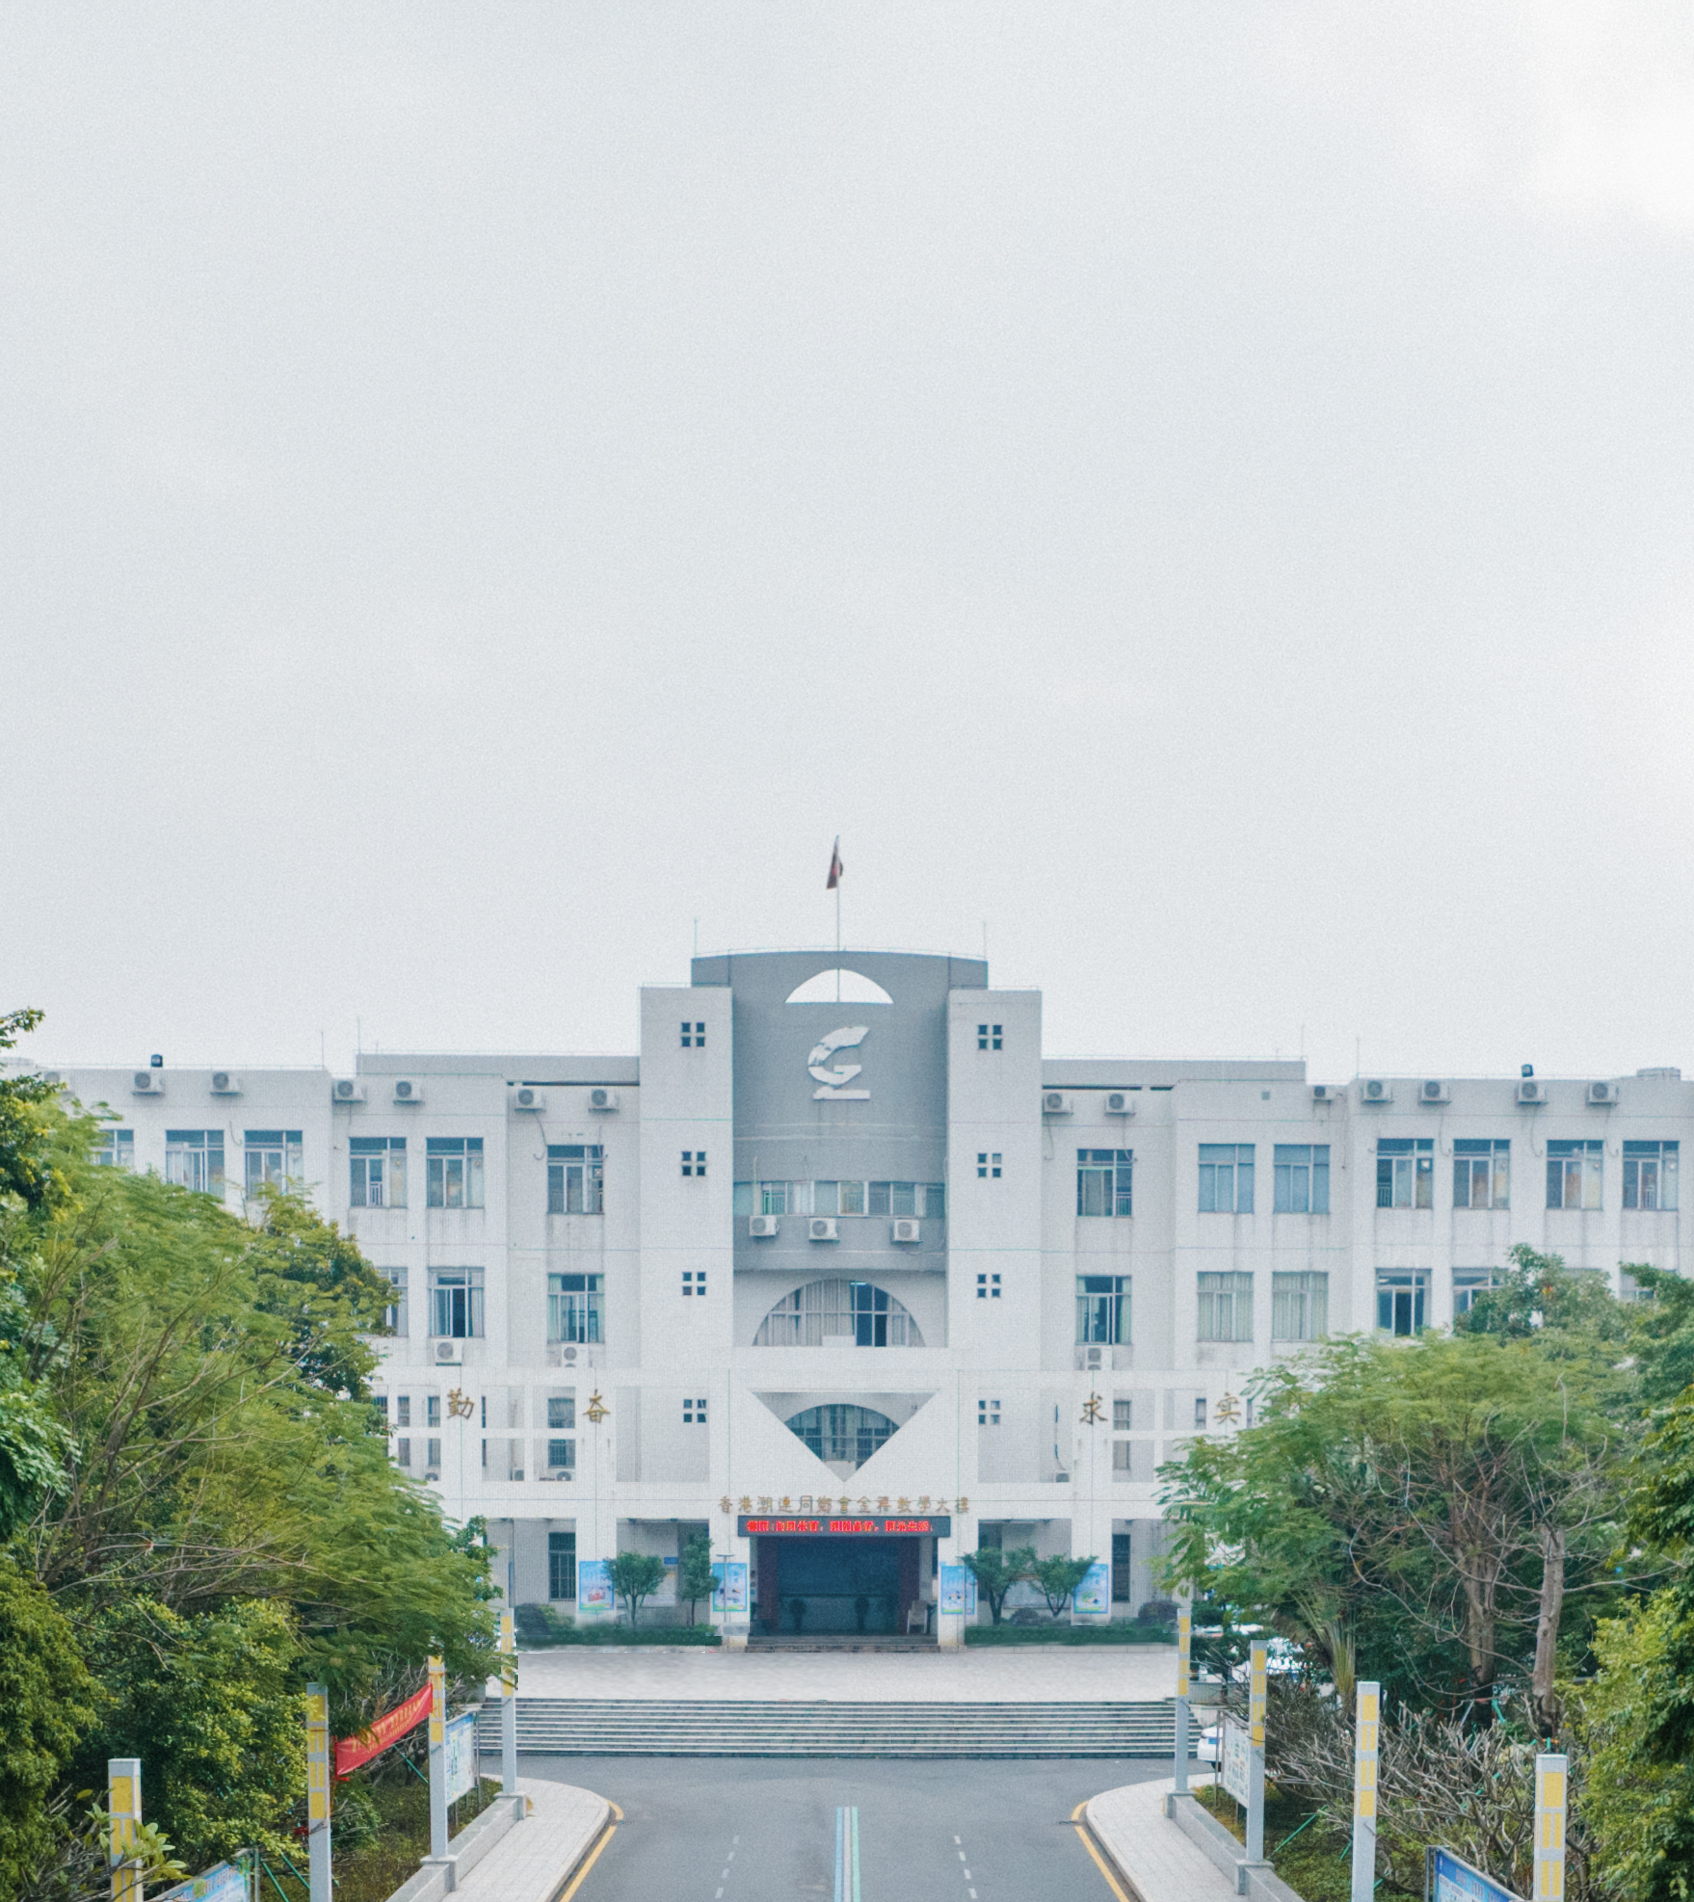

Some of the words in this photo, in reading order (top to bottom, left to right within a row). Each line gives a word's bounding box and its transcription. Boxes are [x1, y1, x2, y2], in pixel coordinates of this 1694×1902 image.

[447, 1388, 475, 1420] 勤
[583, 1389, 611, 1424] 奋
[1079, 1391, 1109, 1426] 求
